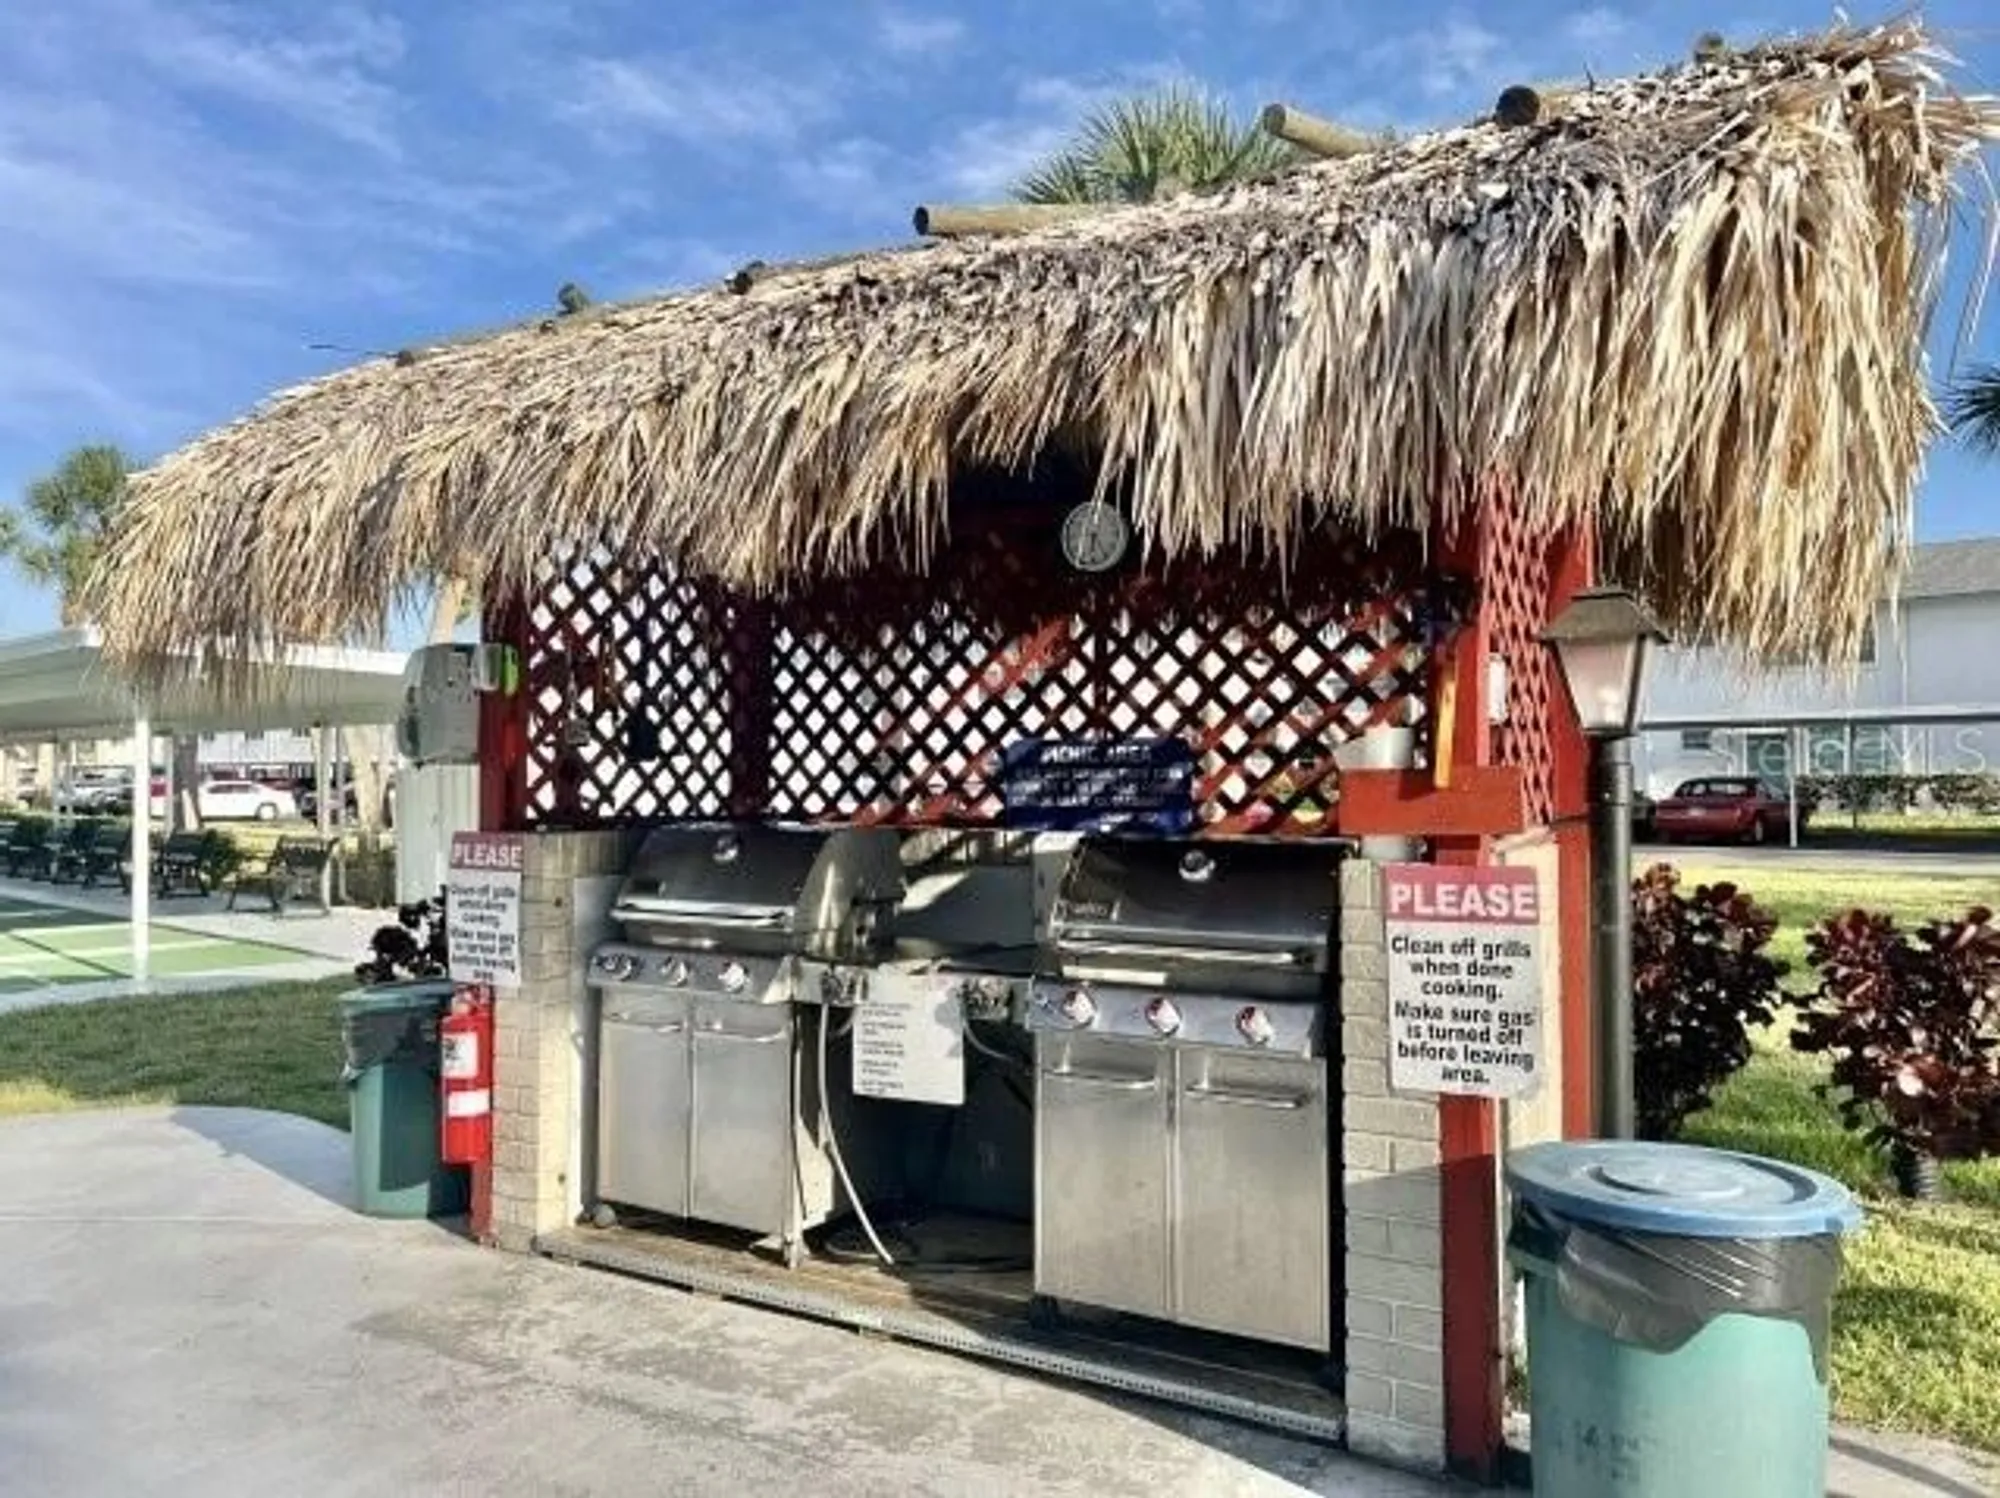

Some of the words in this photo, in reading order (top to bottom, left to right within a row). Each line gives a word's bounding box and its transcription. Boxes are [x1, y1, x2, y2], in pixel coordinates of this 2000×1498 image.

[451, 843, 523, 868] PLEASE
[1390, 883, 1538, 917] PLEASE
[1391, 936, 1443, 955] Clean
[1450, 937, 1475, 956] off
[1482, 939, 1531, 961] grills
[1409, 957, 1460, 975] when
[1467, 959, 1513, 979] done
[1421, 980, 1503, 1003] cooking.
[1395, 1001, 1443, 1020] Make
[1451, 1008, 1493, 1023] sure
[1498, 1011, 1535, 1029] gas
[1407, 1025, 1422, 1039] is
[1428, 1024, 1490, 1044] turned
[1497, 1028, 1523, 1045] off
[1398, 1041, 1457, 1061] before
[1463, 1045, 1534, 1073] leaving
[1441, 1067, 1490, 1084] area.
